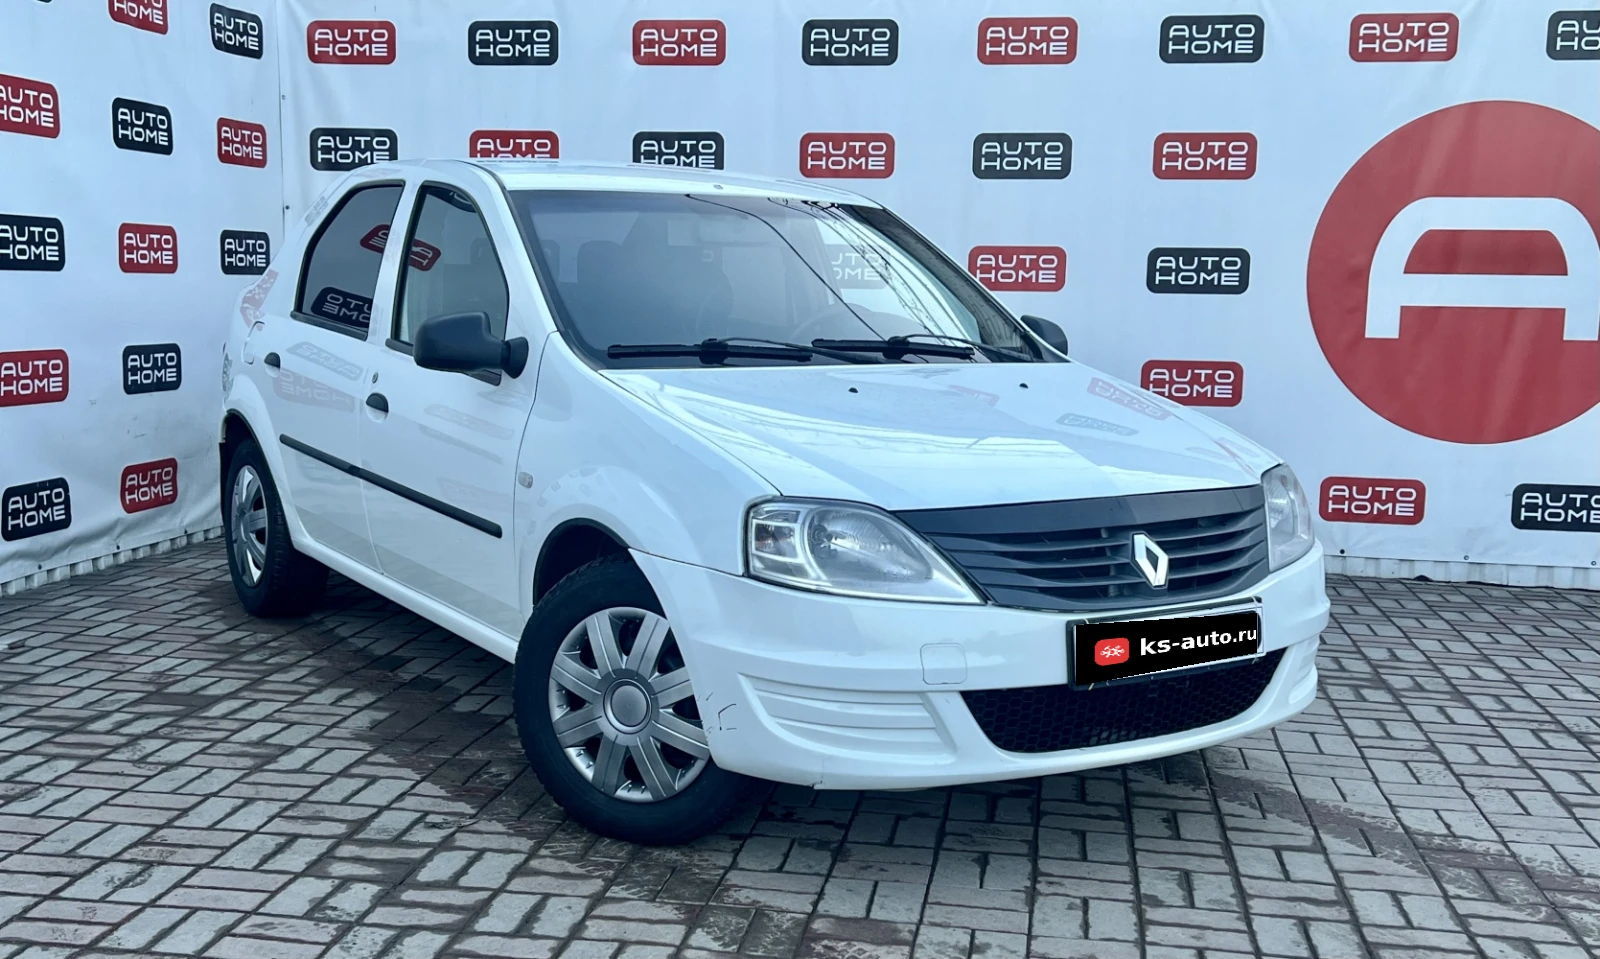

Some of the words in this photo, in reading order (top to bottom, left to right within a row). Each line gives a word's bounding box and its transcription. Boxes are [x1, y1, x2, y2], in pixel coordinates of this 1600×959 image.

[114, 0, 164, 25] HOME
[214, 12, 259, 35] AUTO
[1169, 23, 1255, 38] AUTO
[1358, 22, 1449, 38] AUTO
[215, 28, 259, 50] HOME
[314, 28, 388, 42] AUTO
[476, 28, 551, 42] AUTO
[640, 27, 717, 42] AUTO
[811, 27, 891, 41] AUTO
[986, 25, 1069, 40] AUTO
[314, 43, 388, 56] HOME
[476, 43, 551, 56] HOME
[640, 43, 717, 56] HOME
[810, 42, 890, 57] HOME
[985, 41, 1068, 56] HOME
[1168, 39, 1254, 55] HOME
[1357, 38, 1448, 54] HOME
[117, 108, 168, 129] AUTO
[118, 124, 168, 145] HOME
[221, 126, 263, 144] AUTO
[317, 136, 390, 149] AUTO
[477, 138, 552, 152] AUTO
[641, 139, 717, 153] AUTO
[809, 141, 886, 155] AUTO
[982, 140, 1063, 156] AUTO
[1163, 140, 1248, 156] AUTO
[222, 141, 263, 160] HOME
[317, 150, 390, 163] HOME
[640, 154, 716, 168] HOME
[808, 156, 885, 170] HOME
[981, 156, 1063, 171] HOME
[1162, 156, 1248, 171] HOME
[124, 232, 173, 248] AUTO
[224, 239, 266, 253] AUTO
[124, 249, 173, 265] HOME
[225, 252, 266, 266] HOME
[977, 254, 1058, 269] AUTO
[1156, 256, 1242, 270] AUTO
[976, 269, 1056, 283] HOME
[1155, 271, 1240, 286] HOME
[127, 352, 177, 368] AUTO
[1, 360, 63, 376] AUTO
[128, 368, 177, 384] HOME
[1150, 369, 1234, 383] AUTO
[1, 377, 63, 396] HOME
[1149, 382, 1233, 397] HOME
[126, 468, 173, 488] AUTO
[8, 487, 64, 512] AUTO
[126, 483, 173, 503] HOME
[1329, 485, 1416, 500] AUTO
[1327, 499, 1414, 515] HOME
[8, 505, 66, 530] HOME
